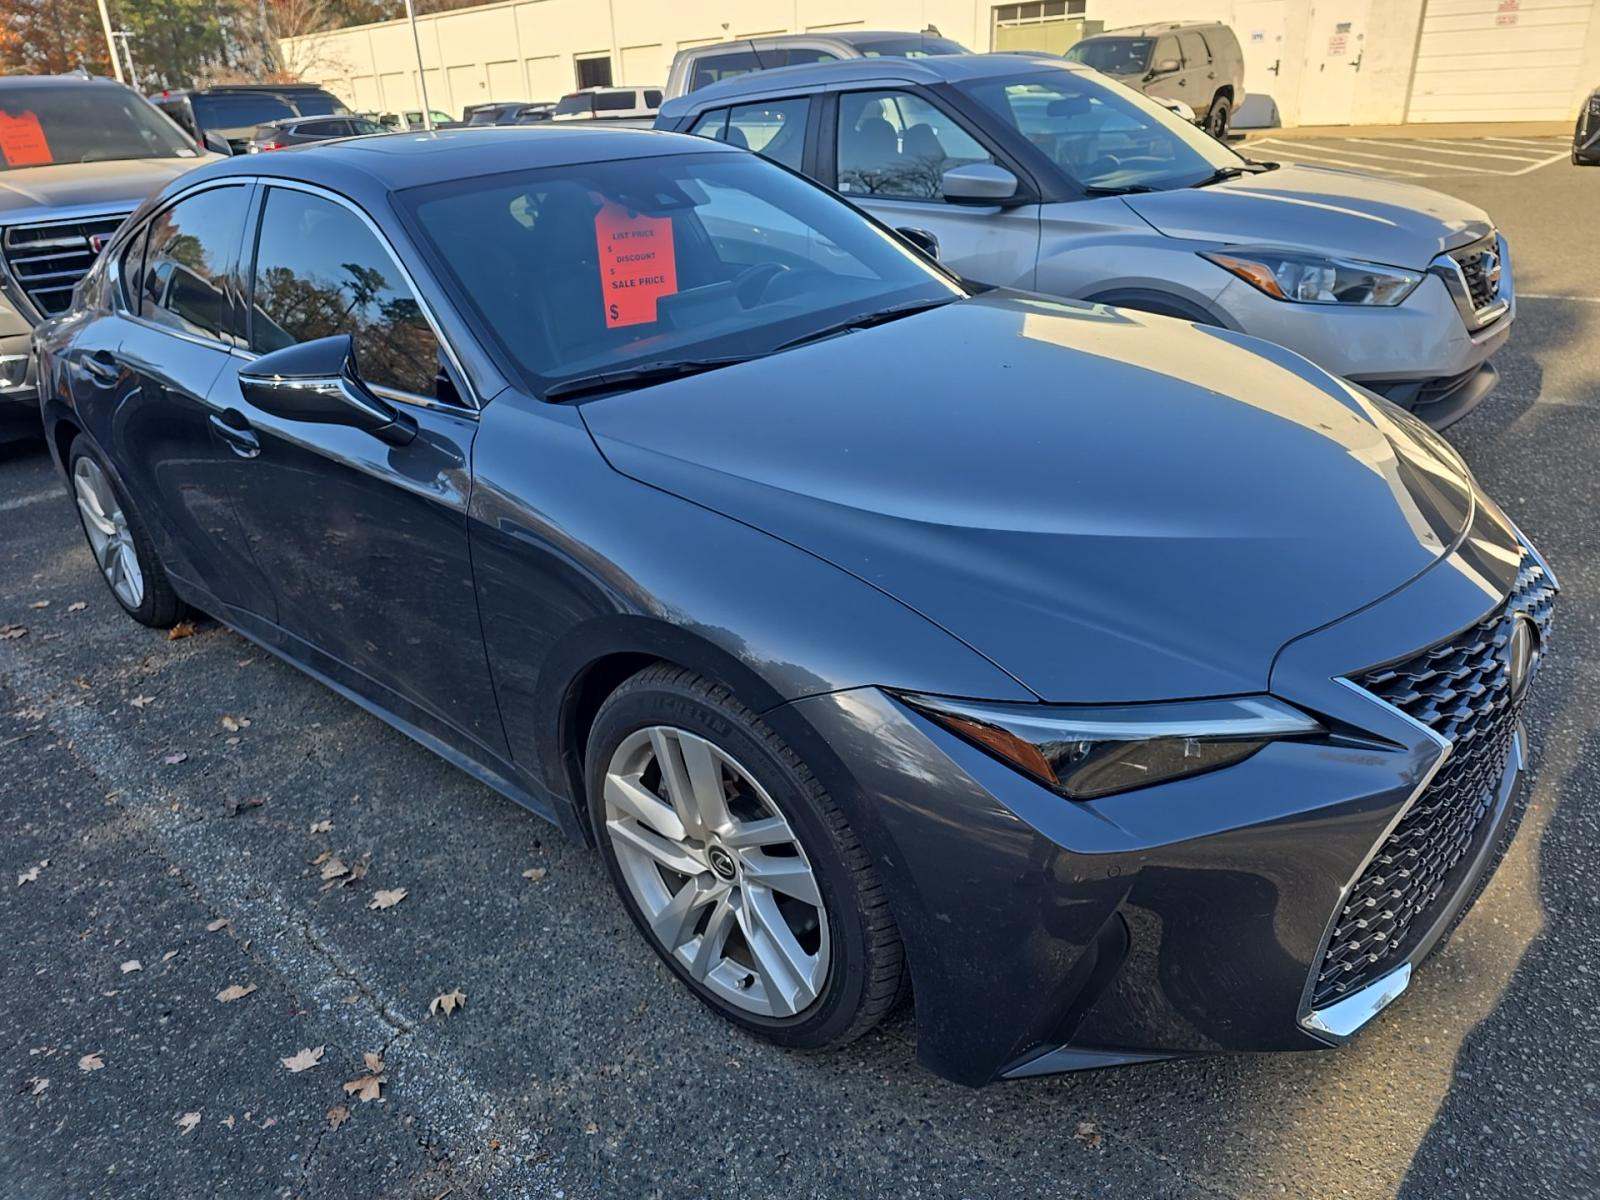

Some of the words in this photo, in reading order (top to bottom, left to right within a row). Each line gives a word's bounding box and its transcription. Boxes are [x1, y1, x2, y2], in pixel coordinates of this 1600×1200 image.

[612, 232, 628, 240] LIST
[631, 230, 654, 238] PRICE
[616, 252, 656, 263] DISCOUNT
[612, 280, 636, 290] SALE
[638, 275, 665, 286] PRICE
[610, 304, 619, 320] $
